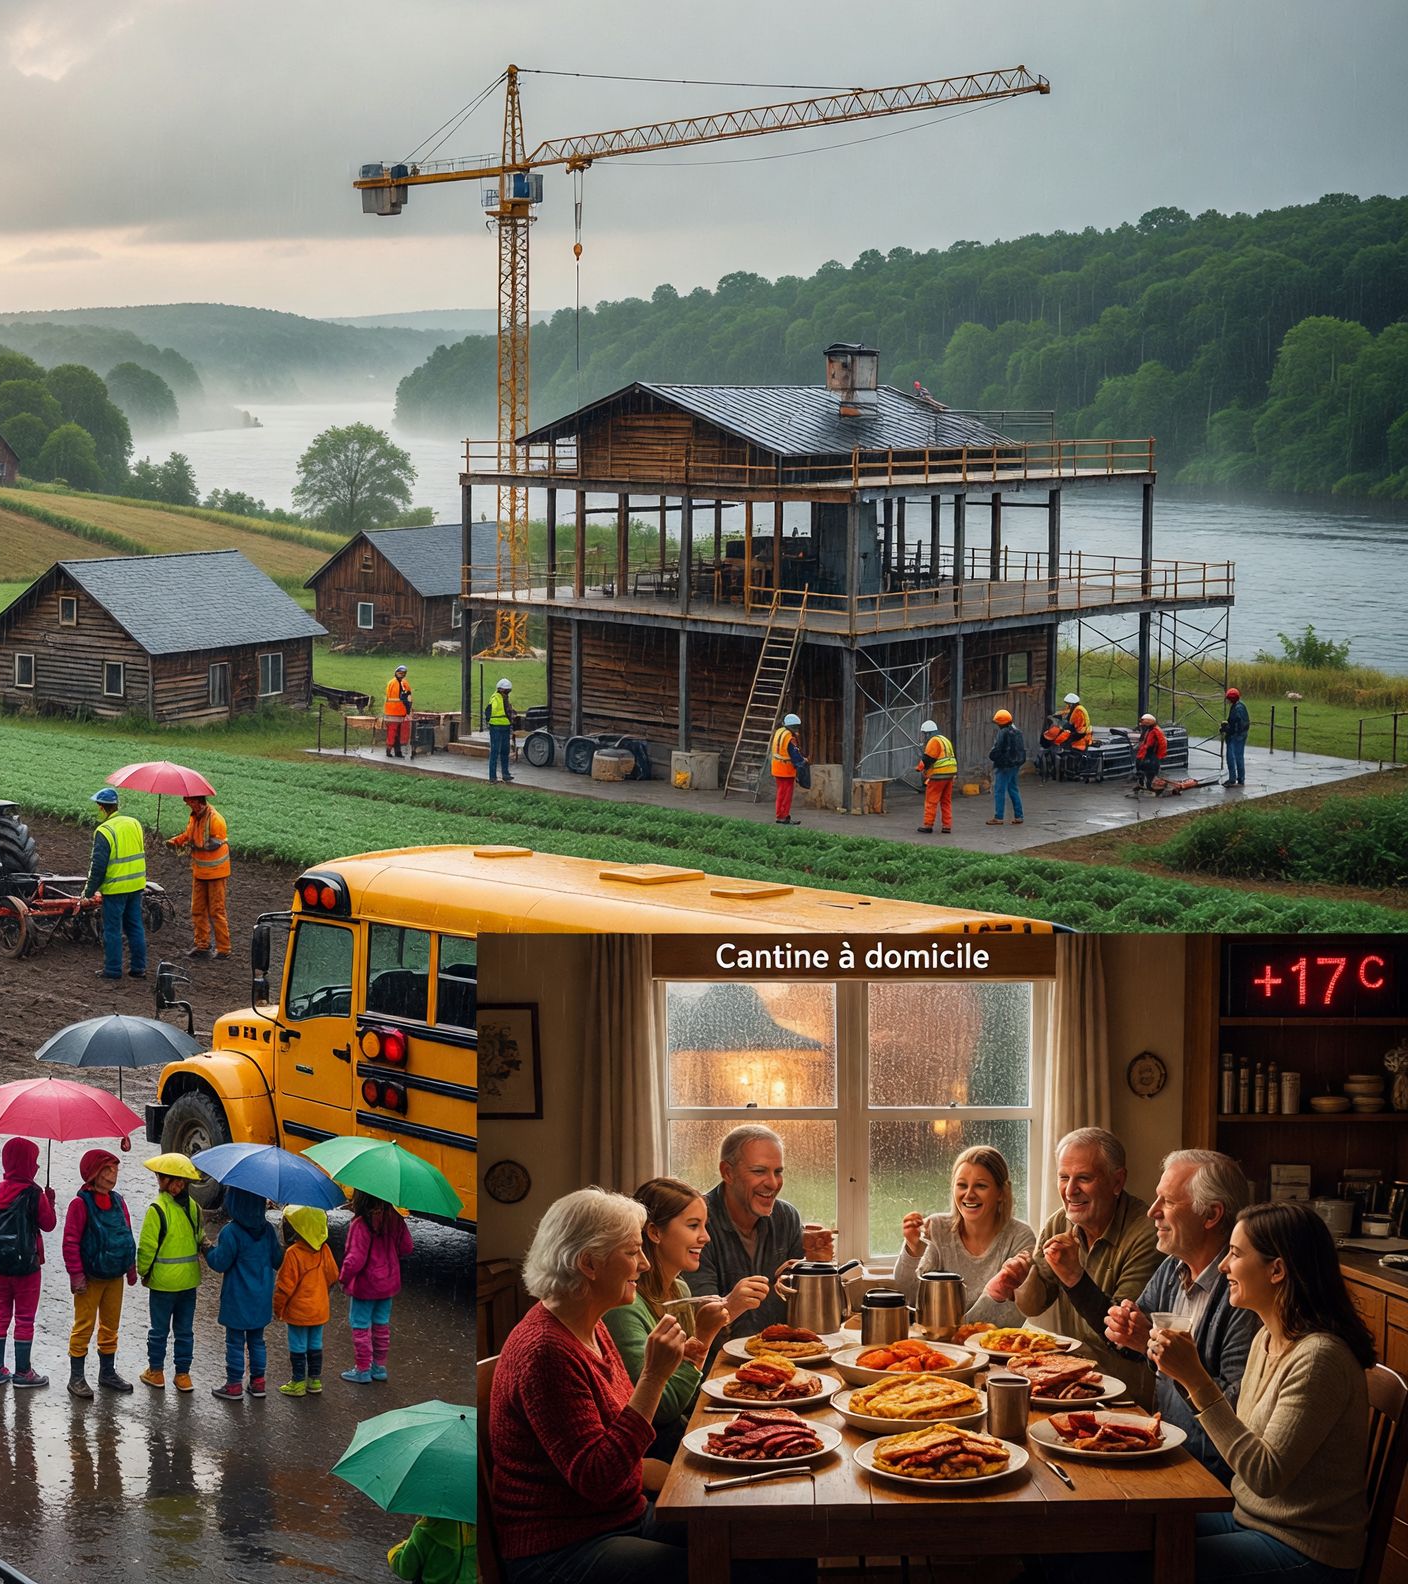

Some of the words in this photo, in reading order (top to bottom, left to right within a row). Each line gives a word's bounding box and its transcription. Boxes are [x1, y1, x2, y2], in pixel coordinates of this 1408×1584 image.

[715, 942, 830, 972] Cantine
[838, 941, 856, 970] à
[865, 941, 990, 971] domicile
